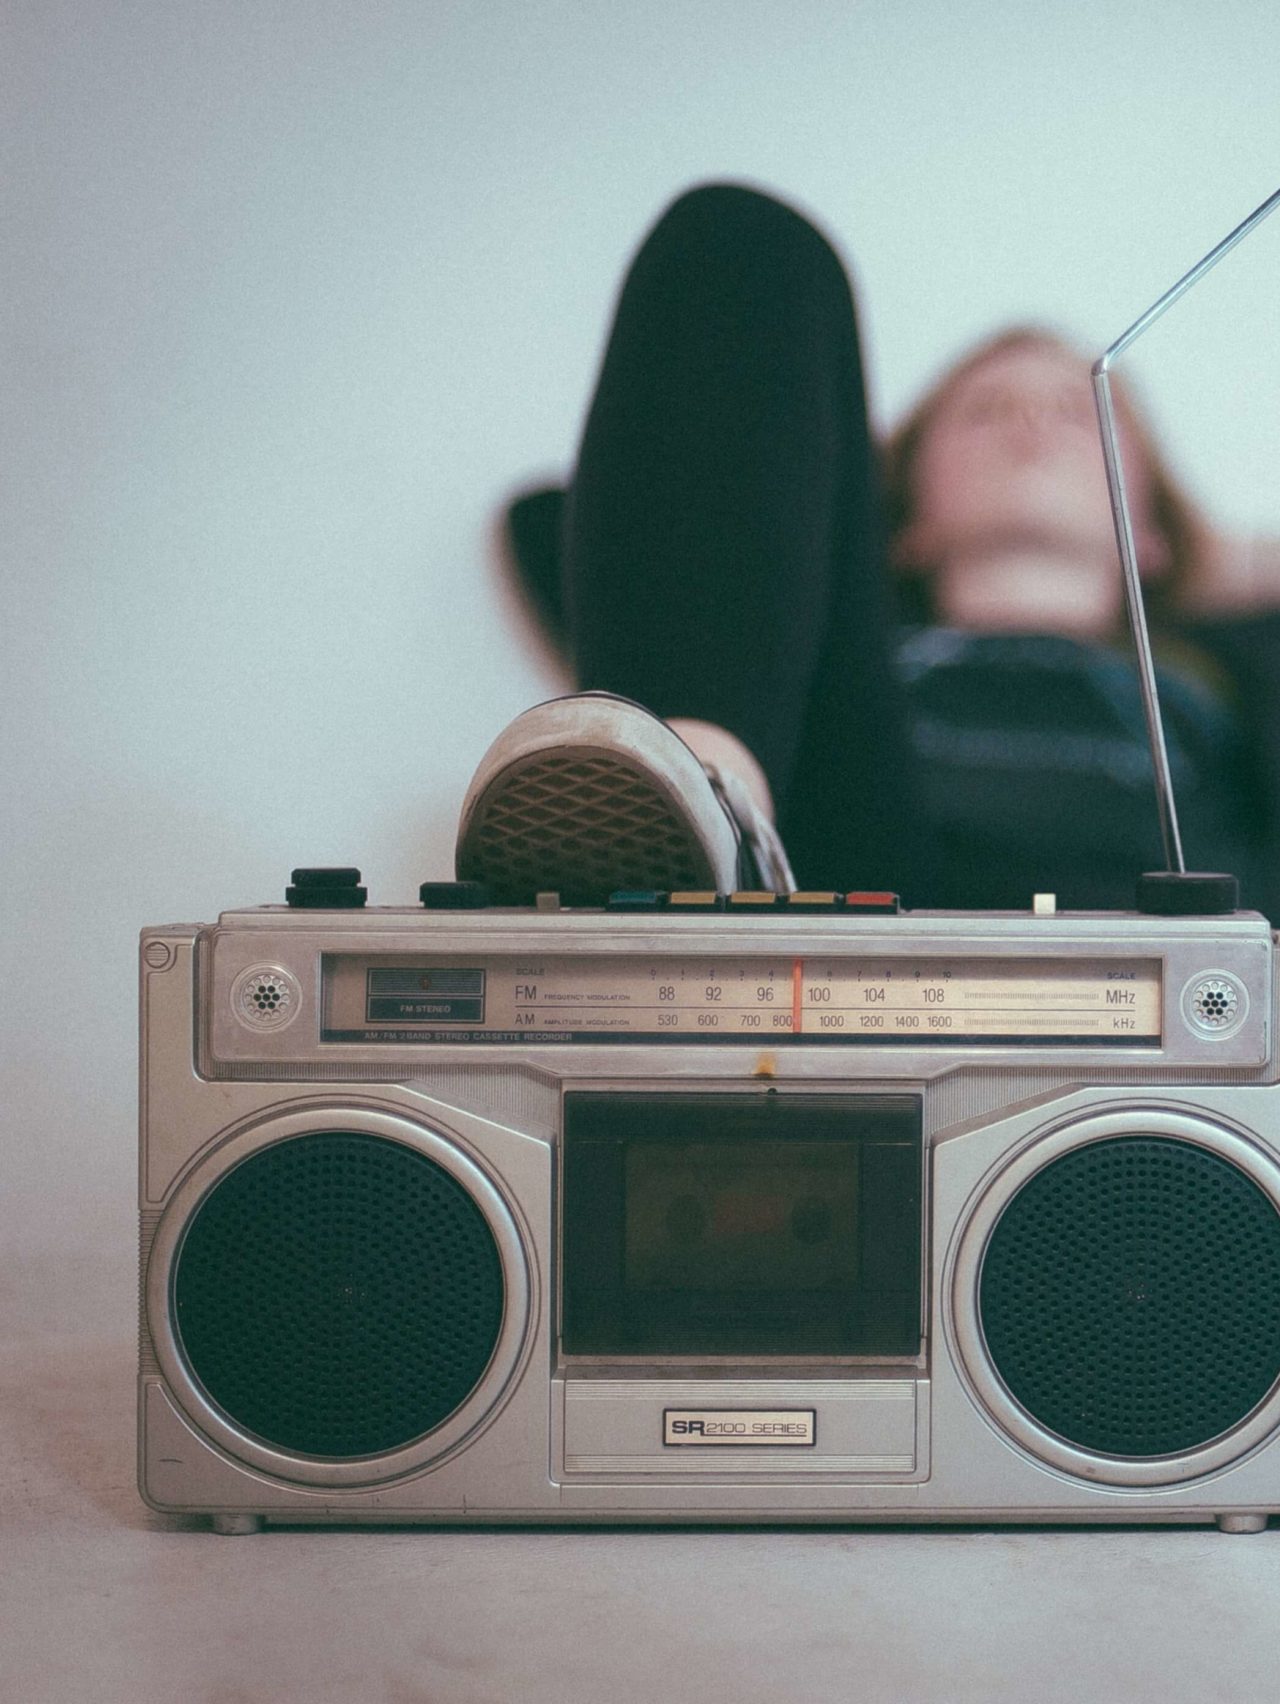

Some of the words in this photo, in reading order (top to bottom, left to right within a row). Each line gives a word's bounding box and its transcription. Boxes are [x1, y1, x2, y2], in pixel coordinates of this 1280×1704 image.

[516, 968, 545, 976] SCALE
[515, 985, 537, 1000] FM
[658, 986, 675, 1001] 88
[705, 986, 722, 1001] 92
[757, 987, 774, 1001] 96
[808, 987, 831, 1002] 100
[863, 988, 886, 1002] 104
[922, 988, 945, 1003] 108
[1106, 989, 1136, 1005] MHz
[400, 1004, 413, 1013] FM
[416, 1004, 452, 1013] STEREO
[514, 1013, 535, 1025] AM
[657, 1014, 679, 1026] 530
[697, 1014, 719, 1026] 600
[739, 1015, 761, 1026] 700
[772, 1015, 793, 1026] 800
[819, 1015, 845, 1027] 1000
[859, 1016, 884, 1027] 1200
[895, 1016, 920, 1027] 1400
[927, 1016, 953, 1028] 1600
[1113, 1017, 1136, 1029] kHz
[364, 1031, 398, 1040] AM/FM
[434, 1031, 470, 1040] STEREO
[472, 1032, 520, 1041] CASSETTE
[523, 1032, 573, 1041] RECORDER
[751, 1422, 808, 1434] SERIES
